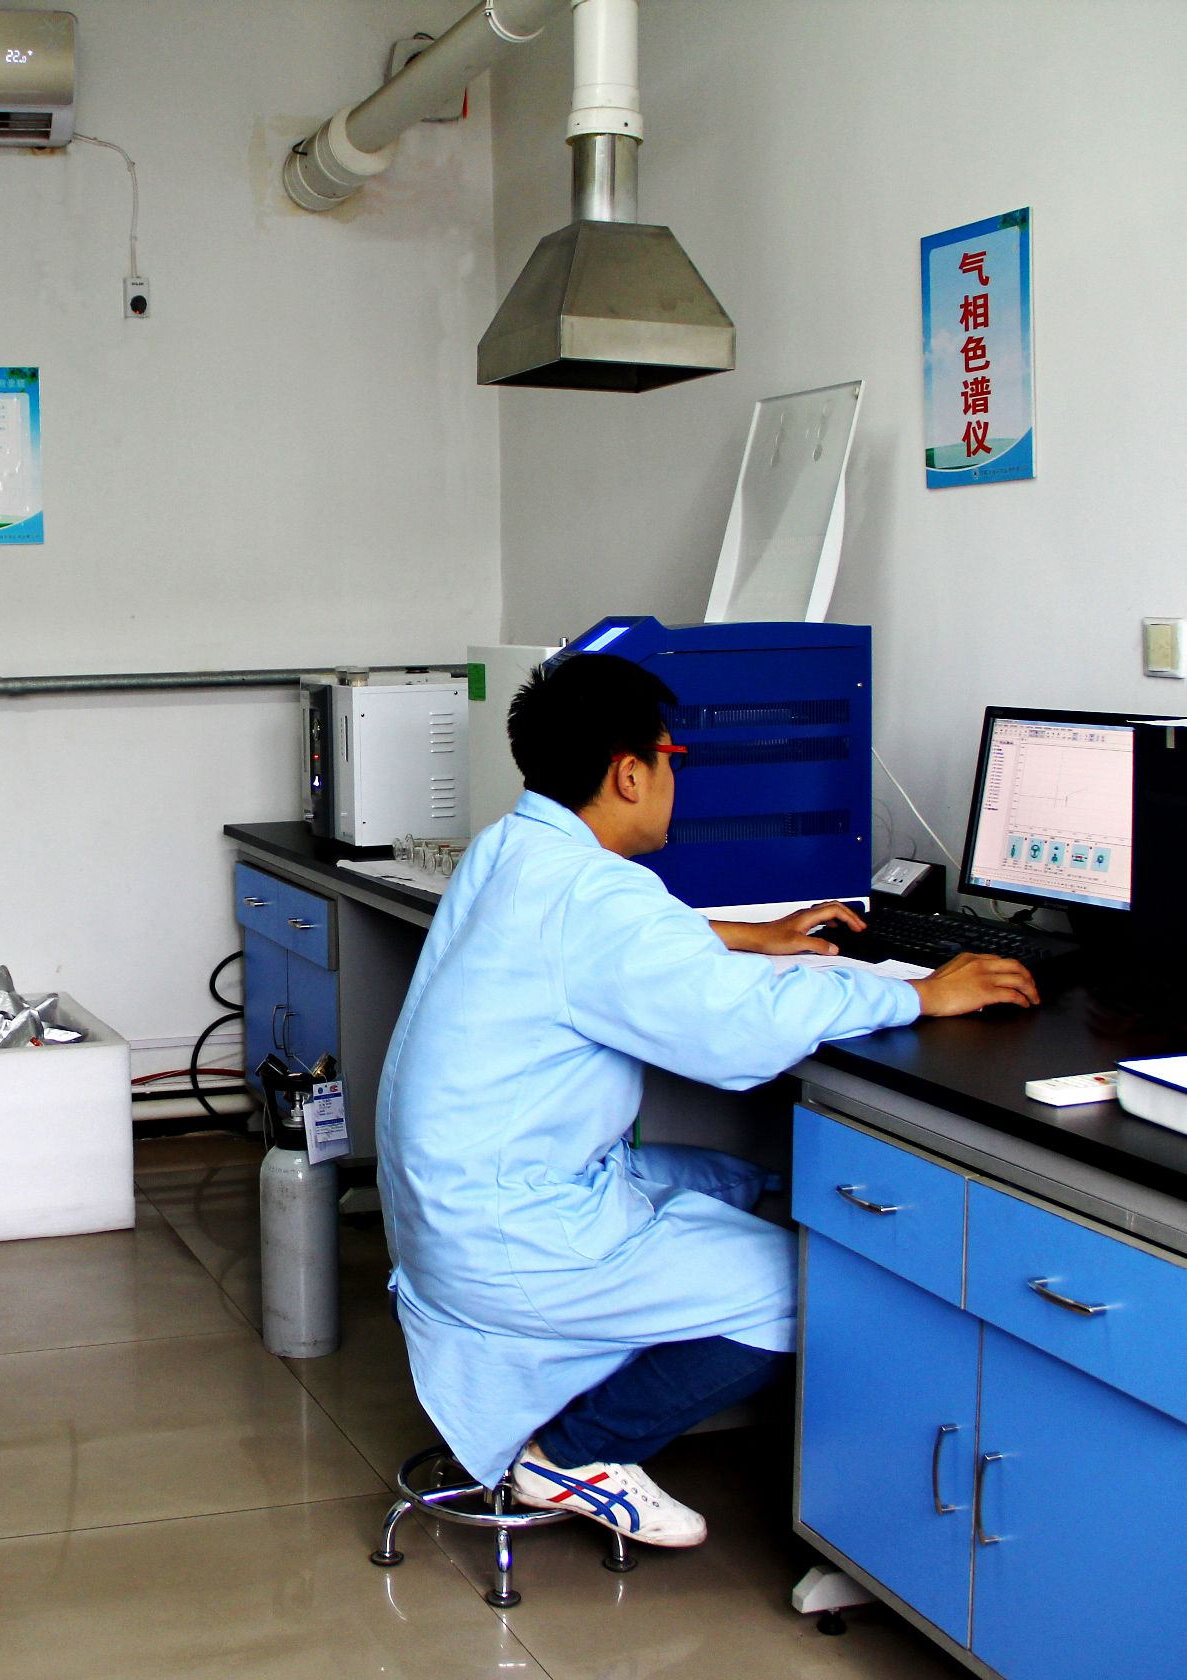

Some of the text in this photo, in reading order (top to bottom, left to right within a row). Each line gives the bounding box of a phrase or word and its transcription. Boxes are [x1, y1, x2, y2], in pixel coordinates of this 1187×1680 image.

[958, 250, 993, 458] 气相色谱仪
